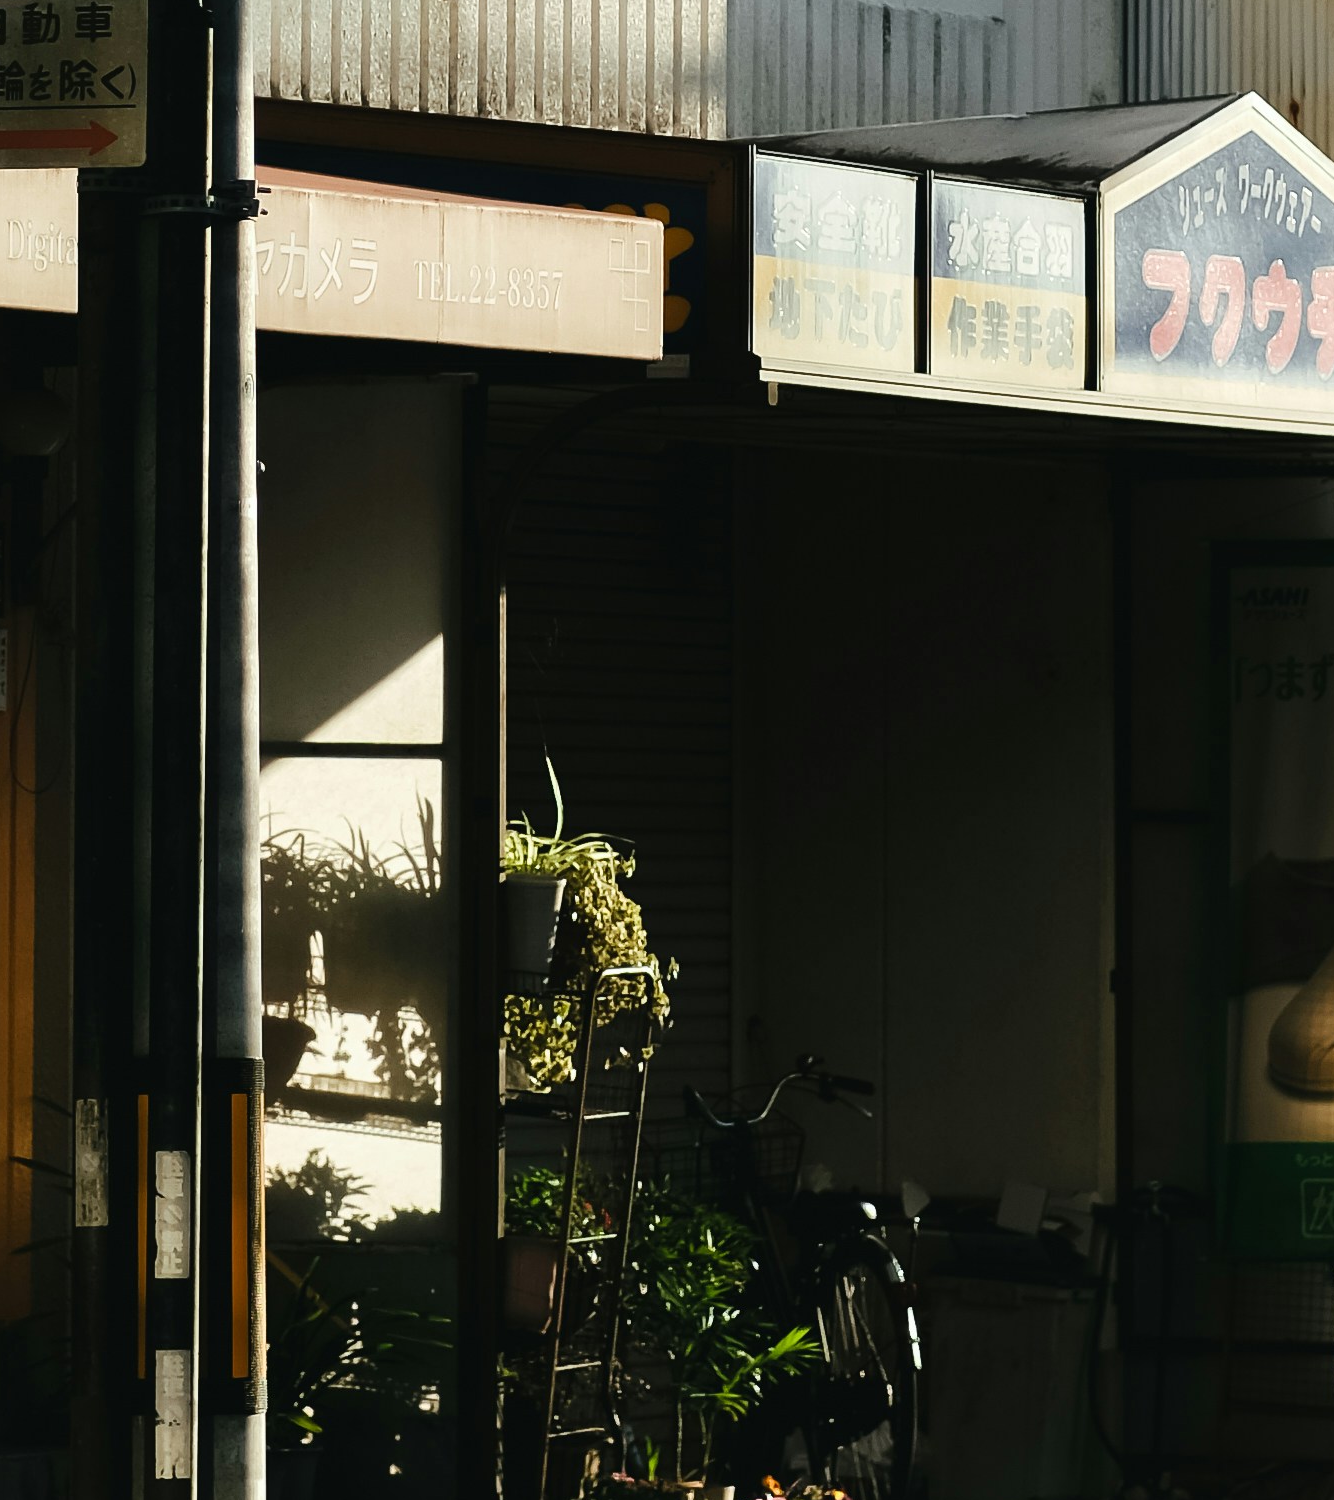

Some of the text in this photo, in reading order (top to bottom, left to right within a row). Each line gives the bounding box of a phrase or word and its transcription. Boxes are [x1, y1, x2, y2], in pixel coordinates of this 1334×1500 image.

[7, 218, 78, 273] Digita
[413, 259, 565, 313] TEL.22-8357
[768, 276, 904, 352] 地下たび
[947, 294, 1075, 370] 作業手袋
